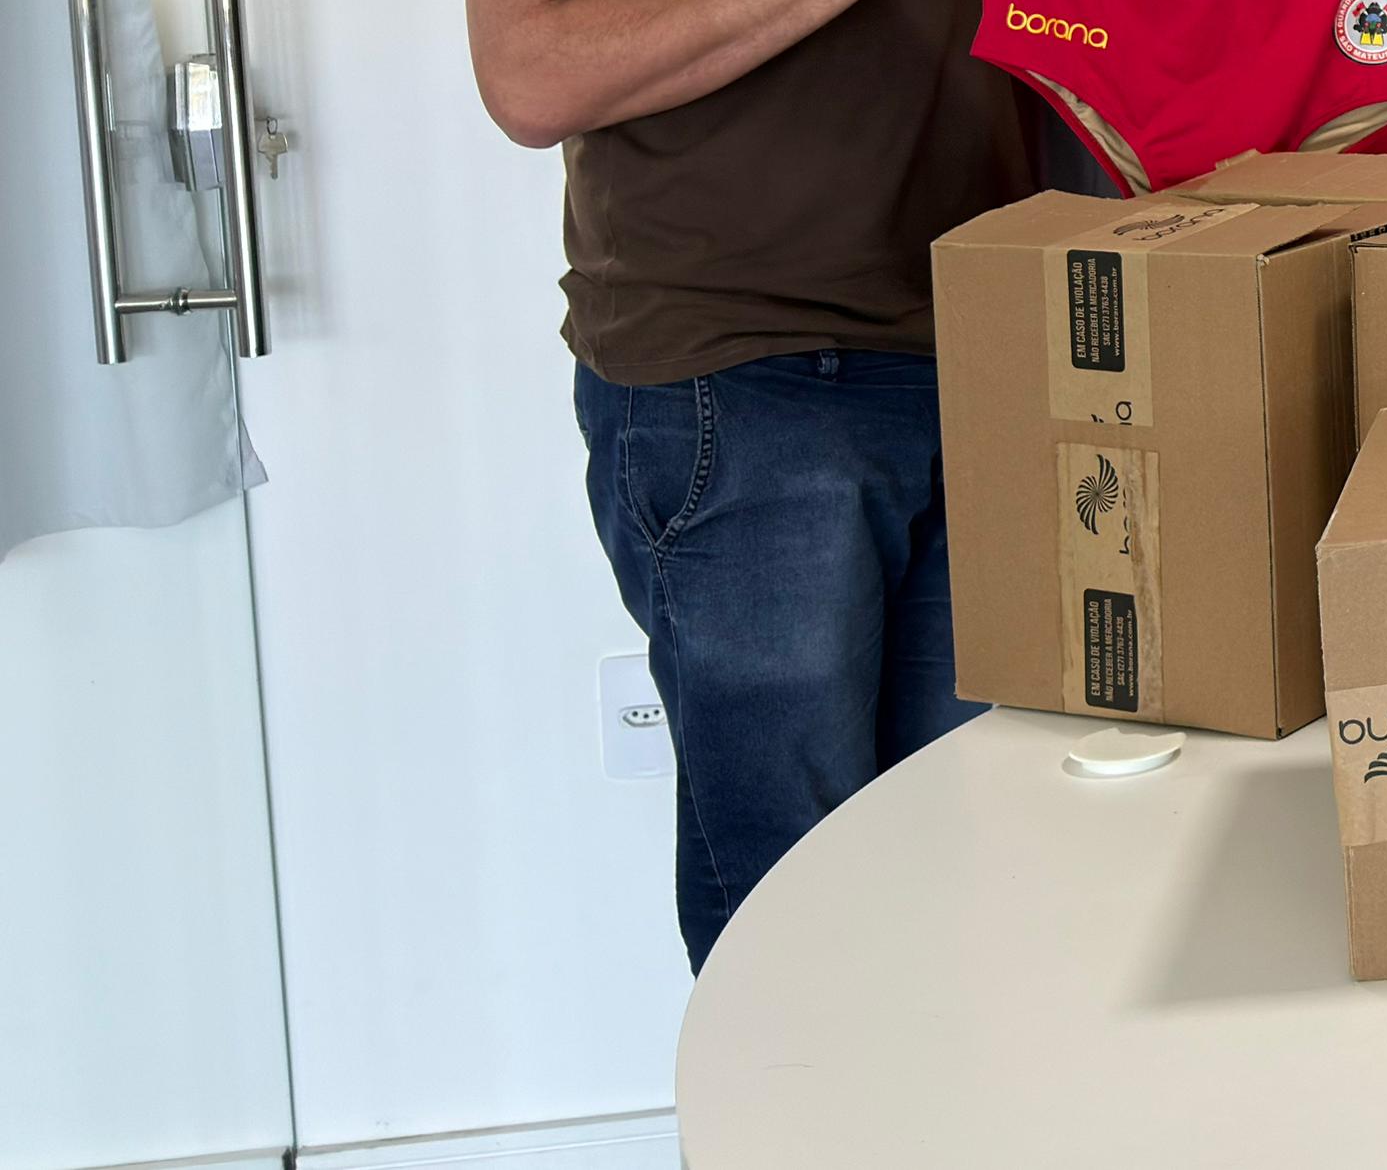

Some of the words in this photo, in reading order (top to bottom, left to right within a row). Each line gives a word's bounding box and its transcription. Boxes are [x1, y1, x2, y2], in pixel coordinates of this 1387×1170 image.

[1006, 3, 1109, 49] borana
[1072, 262, 1084, 304] VIOLAÇÃO
[1075, 306, 1085, 318] DE
[1076, 320, 1086, 343] CASO
[1077, 343, 1087, 358] EM
